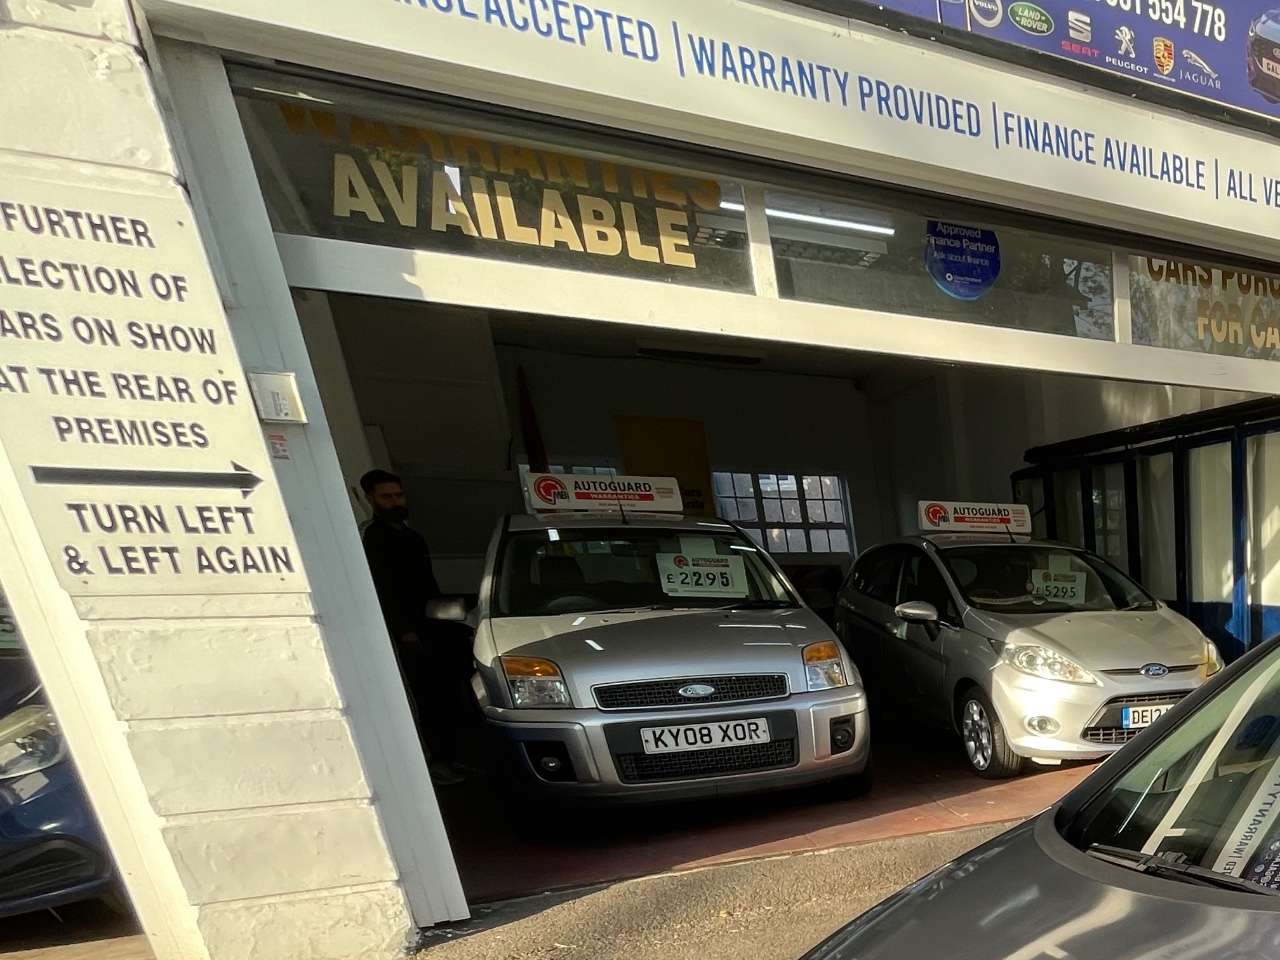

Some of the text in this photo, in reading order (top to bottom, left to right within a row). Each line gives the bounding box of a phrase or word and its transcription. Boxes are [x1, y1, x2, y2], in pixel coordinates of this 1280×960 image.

[1018, 8, 1041, 20] LAND
[1021, 17, 1048, 32] ROVER
[1148, 0, 1187, 29] 554
[1191, 1, 1226, 42] 778
[1061, 40, 1099, 57] SEAT
[1105, 56, 1149, 74] PEUGEOT
[1179, 70, 1222, 90] JAGUAR
[485, 0, 659, 62] ACCEPTED
[687, 33, 849, 108] WARRANTY
[858, 75, 982, 138] PROVIDED
[1004, 111, 1096, 166] FINANCE
[1103, 139, 1206, 191] AVAILABLE
[1226, 168, 1257, 206] ALL
[1, 202, 156, 249] FURTHER
[332, 152, 697, 269] AVAILABLE
[936, 221, 981, 238] Approved
[962, 238, 996, 253] Partner
[0, 255, 189, 303] LECTION OF
[0, 309, 218, 355] ARS ON SHOW
[1197, 298, 1244, 345] FOR
[38, 366, 107, 399] THE
[112, 372, 197, 405] REAR
[201, 377, 238, 407] OF
[52, 415, 210, 449] PREMISES
[573, 480, 652, 493] AUTOGUARD
[65, 502, 256, 535] TURN LEFT
[953, 506, 1010, 517] AUTOGUARD
[63, 544, 296, 576] & LEFT AGAIN
[651, 721, 760, 749] KY08 XOR
